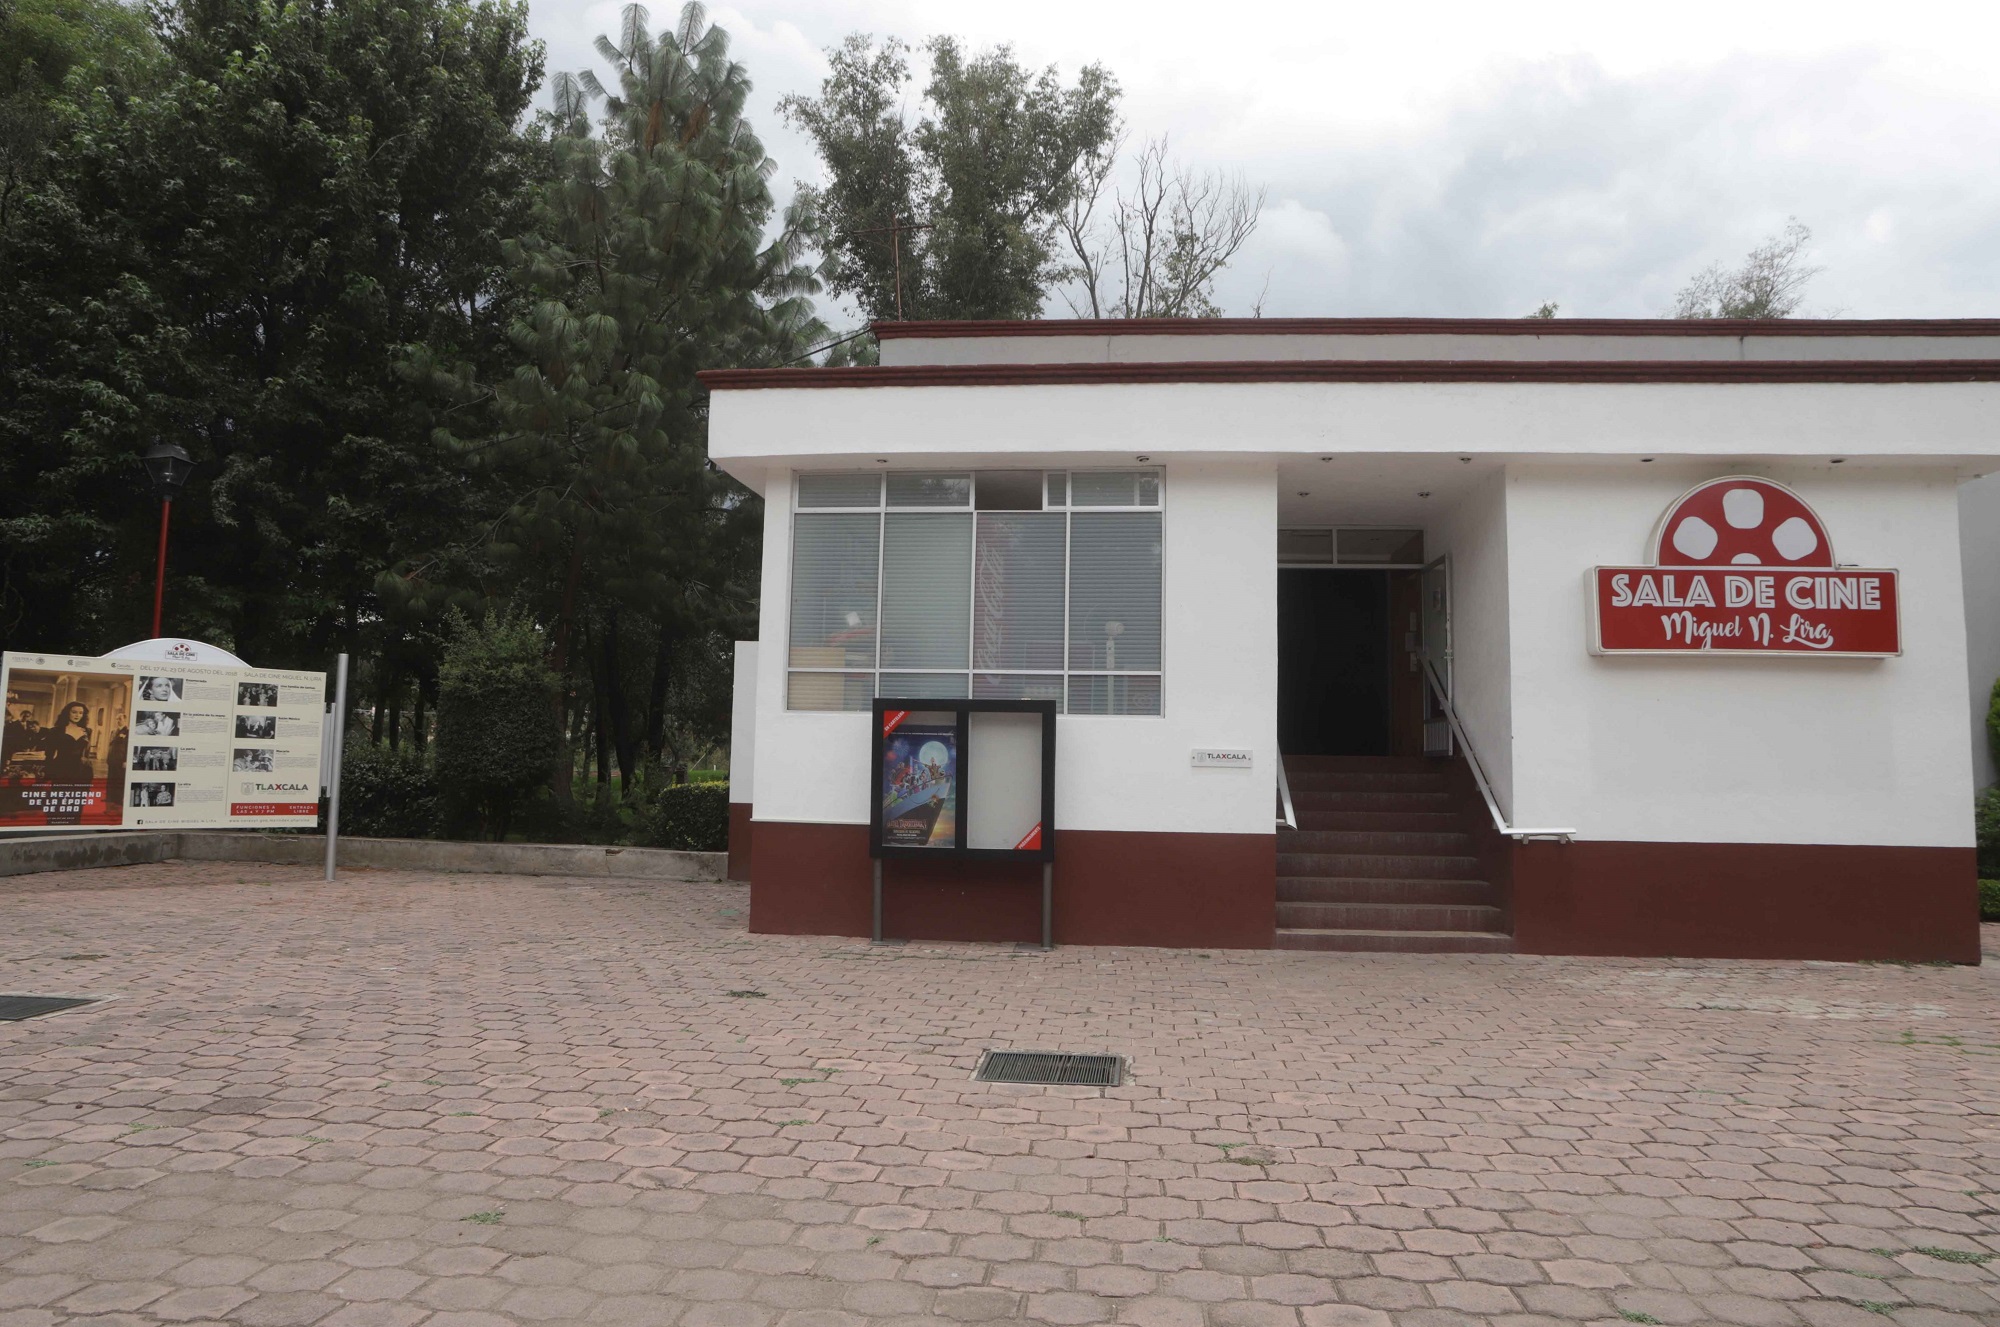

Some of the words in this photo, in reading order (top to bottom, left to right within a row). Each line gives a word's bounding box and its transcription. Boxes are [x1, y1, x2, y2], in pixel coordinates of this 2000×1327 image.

[1611, 573, 1716, 608] SALA
[1724, 575, 1776, 609] DE
[1784, 576, 1881, 611] CINE
[1660, 610, 1743, 650] Miguel
[1748, 612, 1775, 647] N.
[1779, 612, 1834, 649] Lira
[140, 664, 152, 672] DEL
[187, 668, 212, 676] AGOSTO
[255, 783, 309, 791] TLAXCALA
[61, 797, 94, 805] ÉPOCA
